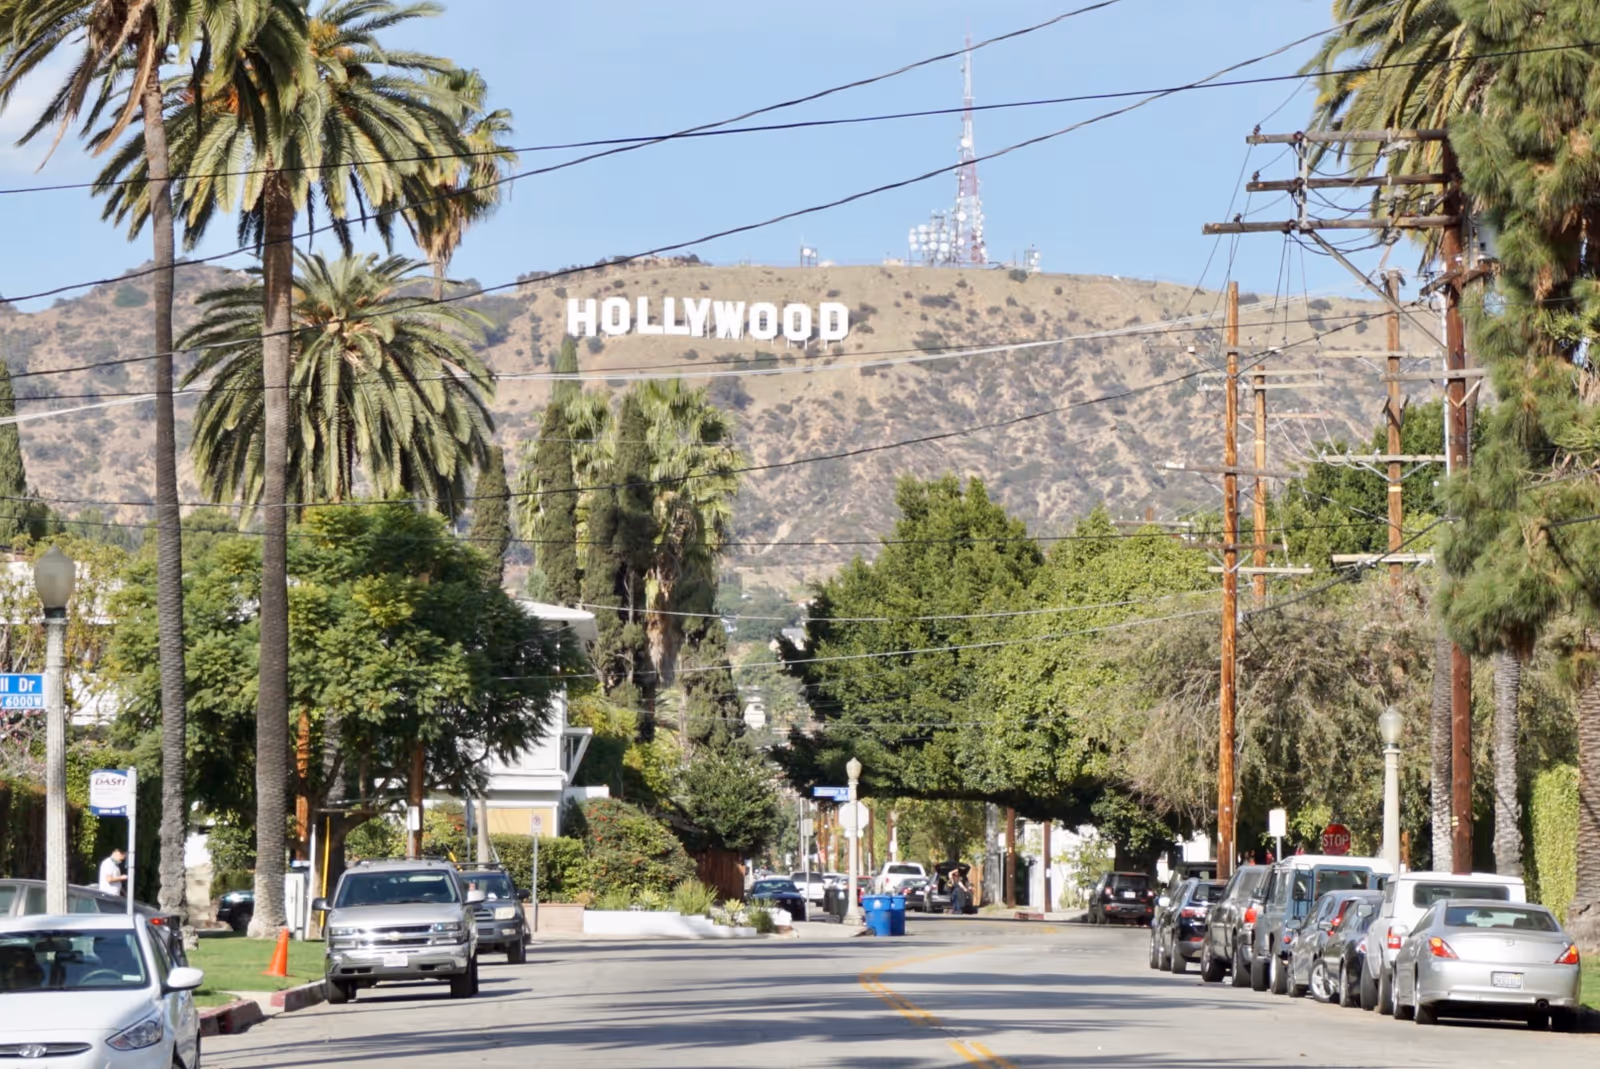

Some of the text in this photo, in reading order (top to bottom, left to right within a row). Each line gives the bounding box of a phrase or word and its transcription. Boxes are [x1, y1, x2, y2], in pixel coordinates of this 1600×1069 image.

[567, 296, 849, 342] HOLLYWOOD
[18, 677, 36, 692] Dr
[1322, 834, 1350, 847] STOP
